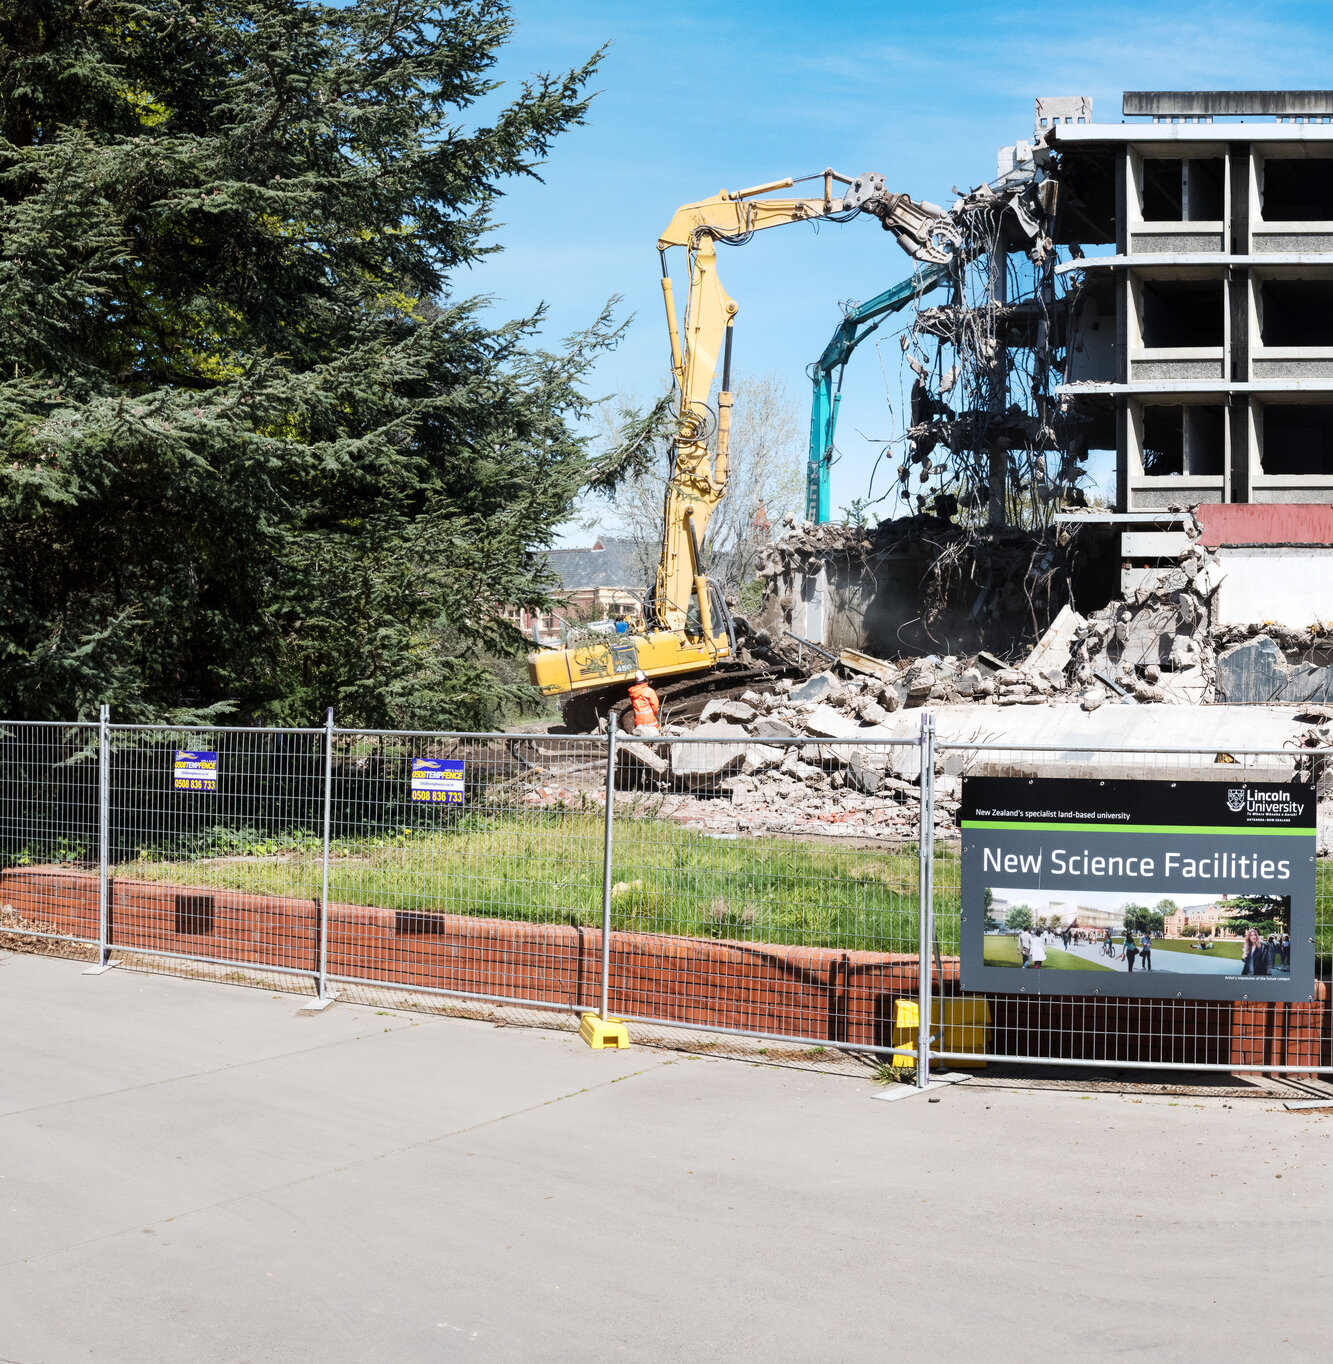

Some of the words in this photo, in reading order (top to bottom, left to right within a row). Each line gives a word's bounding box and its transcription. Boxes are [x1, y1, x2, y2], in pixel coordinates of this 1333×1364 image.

[412, 771, 463, 779] 0508TEMPFENCE
[175, 779, 189, 788] 0508
[190, 780, 202, 789] 836
[204, 780, 216, 790] 733
[412, 790, 430, 801] 0508
[432, 791, 446, 801] 836
[448, 792, 462, 802] 733
[1247, 790, 1290, 801] Lincoln
[976, 808, 990, 816] New
[992, 808, 1024, 817] Zealand's
[1025, 810, 1056, 818] specialist
[1058, 810, 1095, 819] land-based
[1097, 811, 1130, 820] university
[1247, 801, 1304, 815] University
[983, 847, 1042, 873] New
[1050, 849, 1155, 877] Science
[1164, 852, 1290, 879] Facilities
